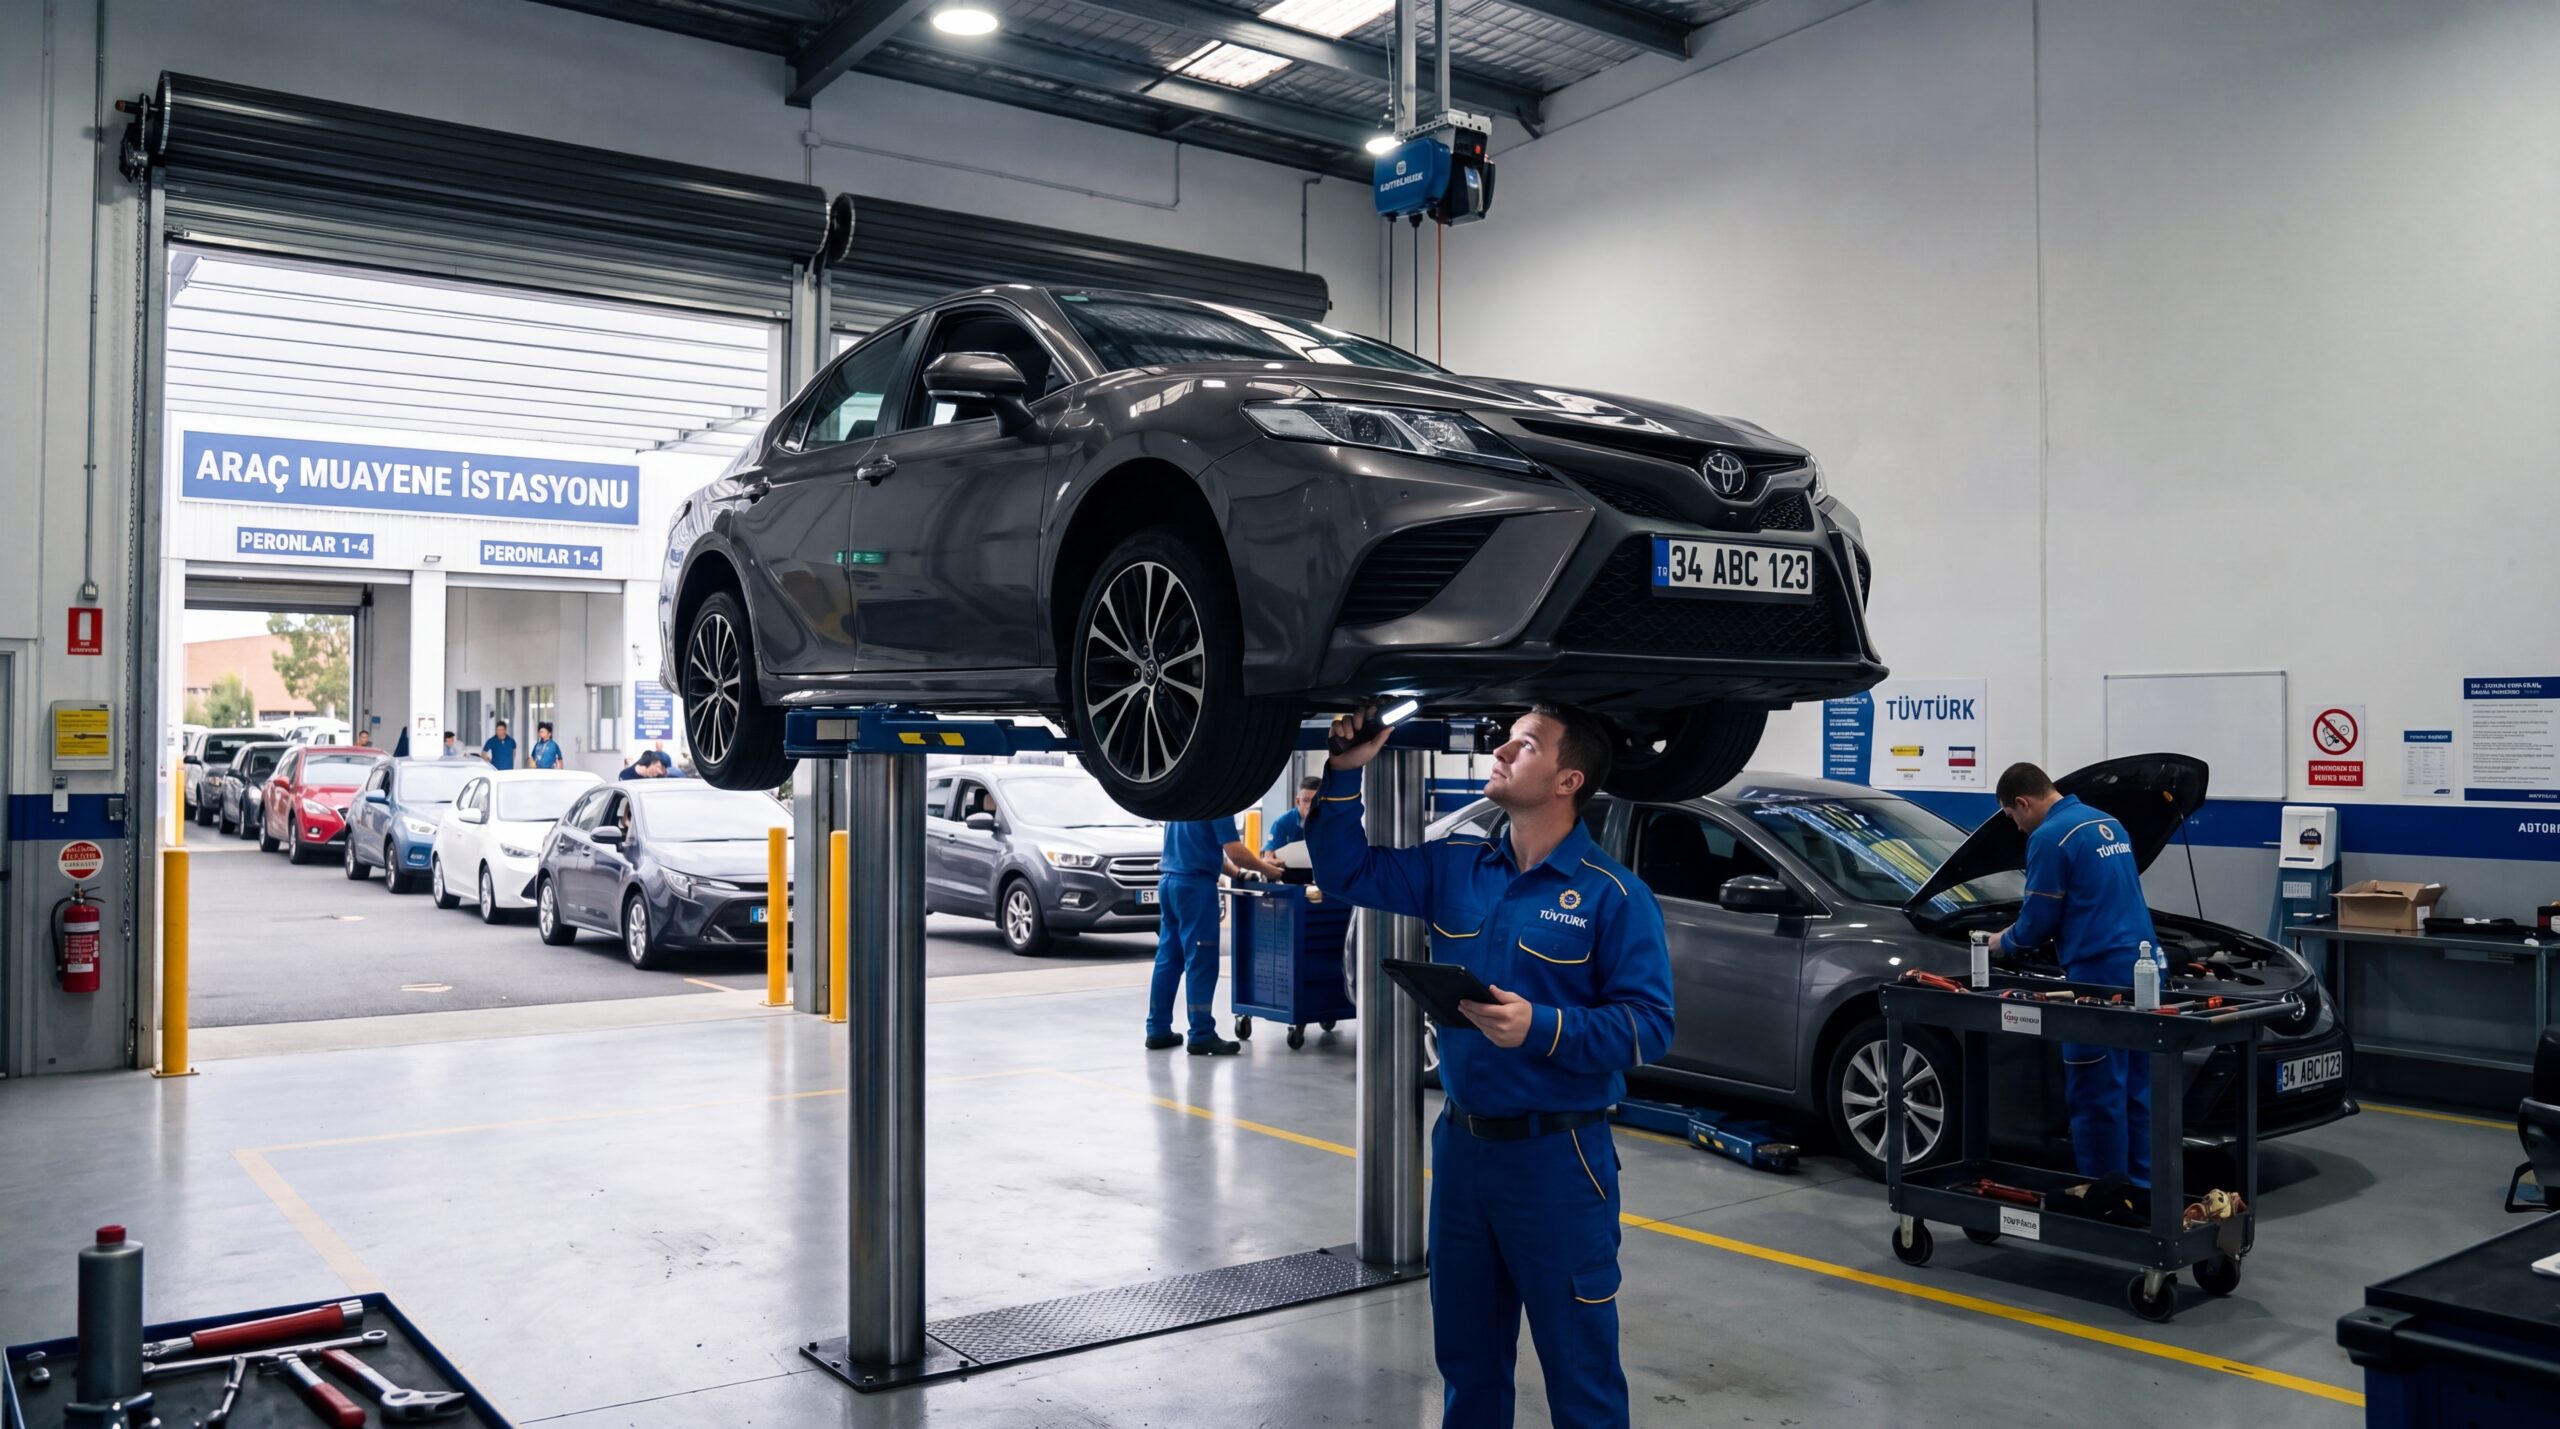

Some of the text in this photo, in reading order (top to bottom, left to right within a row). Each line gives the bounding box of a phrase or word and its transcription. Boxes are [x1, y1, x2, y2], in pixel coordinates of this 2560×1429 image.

[196, 449, 629, 509] ARAÇ MUAYENE İSTASYONU
[240, 531, 370, 554] PERONLAR 1-4
[484, 544, 599, 566] PERONLAR 1-4
[1671, 545, 1809, 590] 34 ABC 123
[1886, 694, 1976, 721] TÜVTÜRK
[2283, 1063, 2295, 1087] 34
